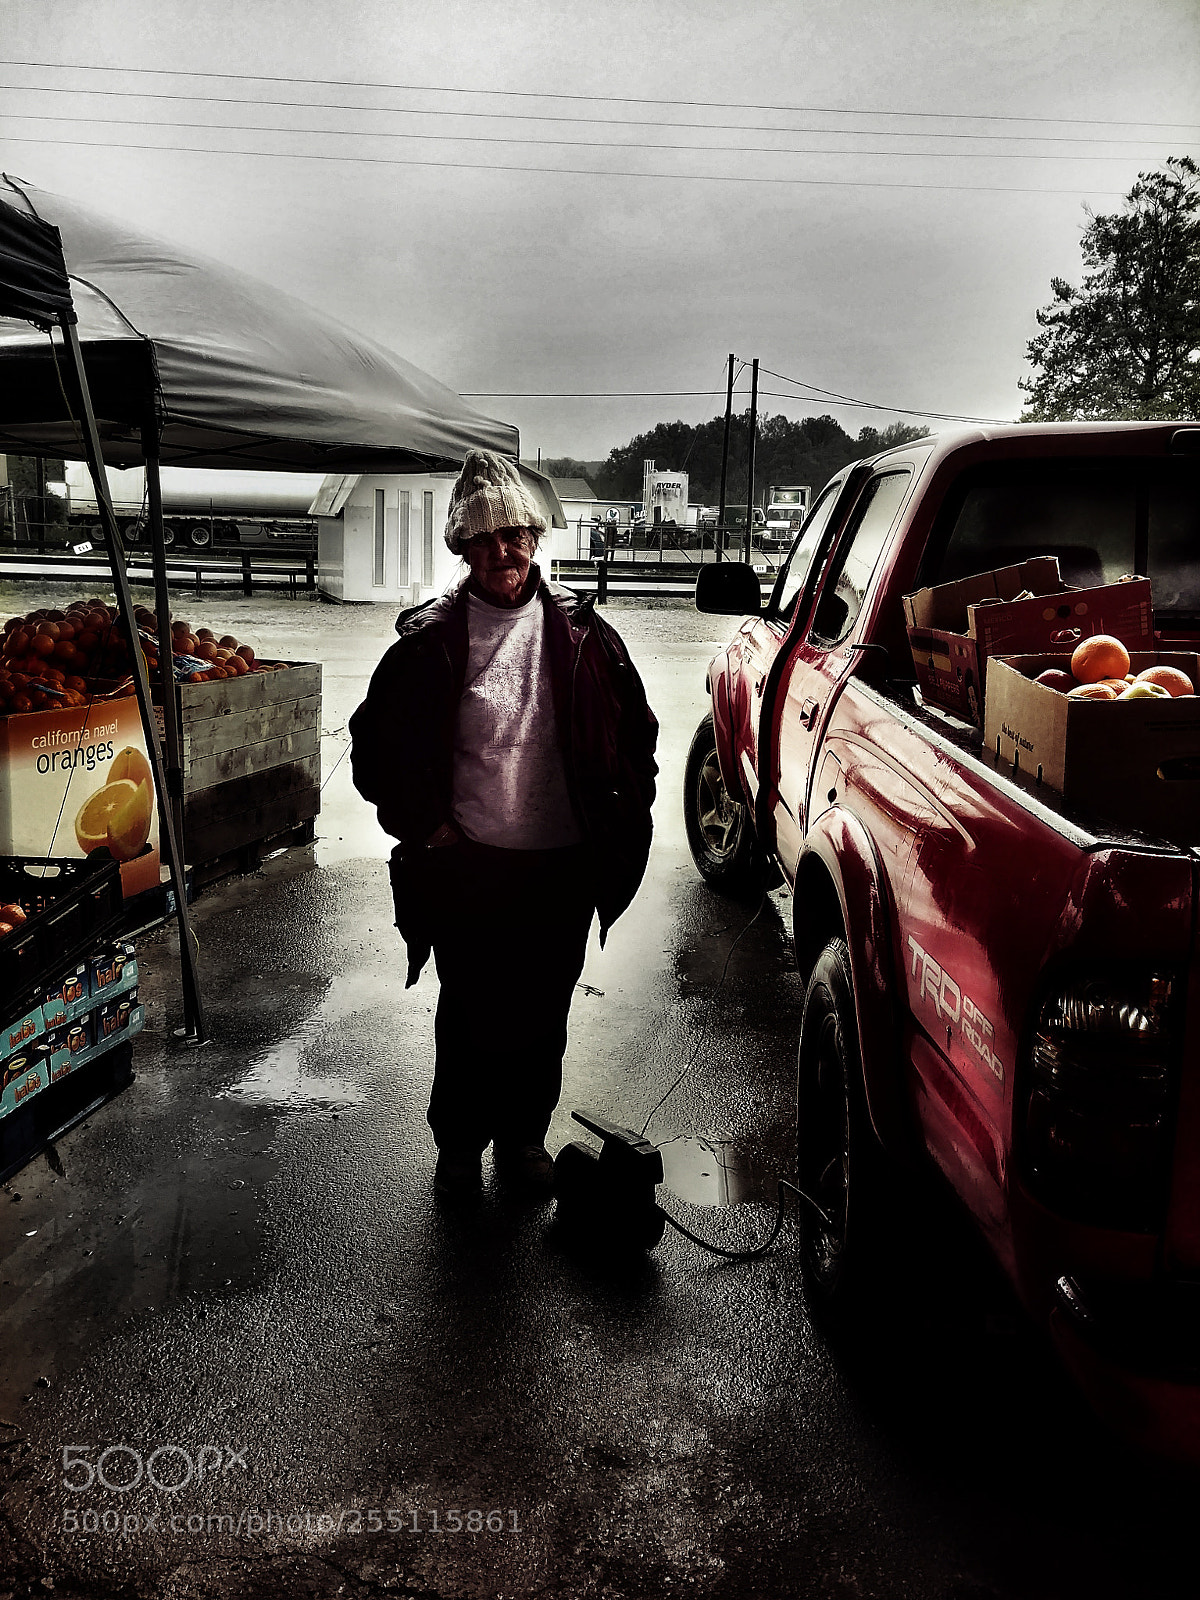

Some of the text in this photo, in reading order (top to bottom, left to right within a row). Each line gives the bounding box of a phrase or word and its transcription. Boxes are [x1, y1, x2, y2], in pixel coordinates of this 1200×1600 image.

[656, 482, 682, 490] RYDER
[31, 718, 118, 749] california navel
[36, 740, 114, 774] oranges
[908, 934, 995, 1037] TRD OFF
[45, 1013, 67, 1030] halos
[9, 1022, 36, 1049] halos
[961, 1017, 1004, 1081] ROAD
[51, 1063, 72, 1082] halos
[14, 1076, 41, 1103] halos
